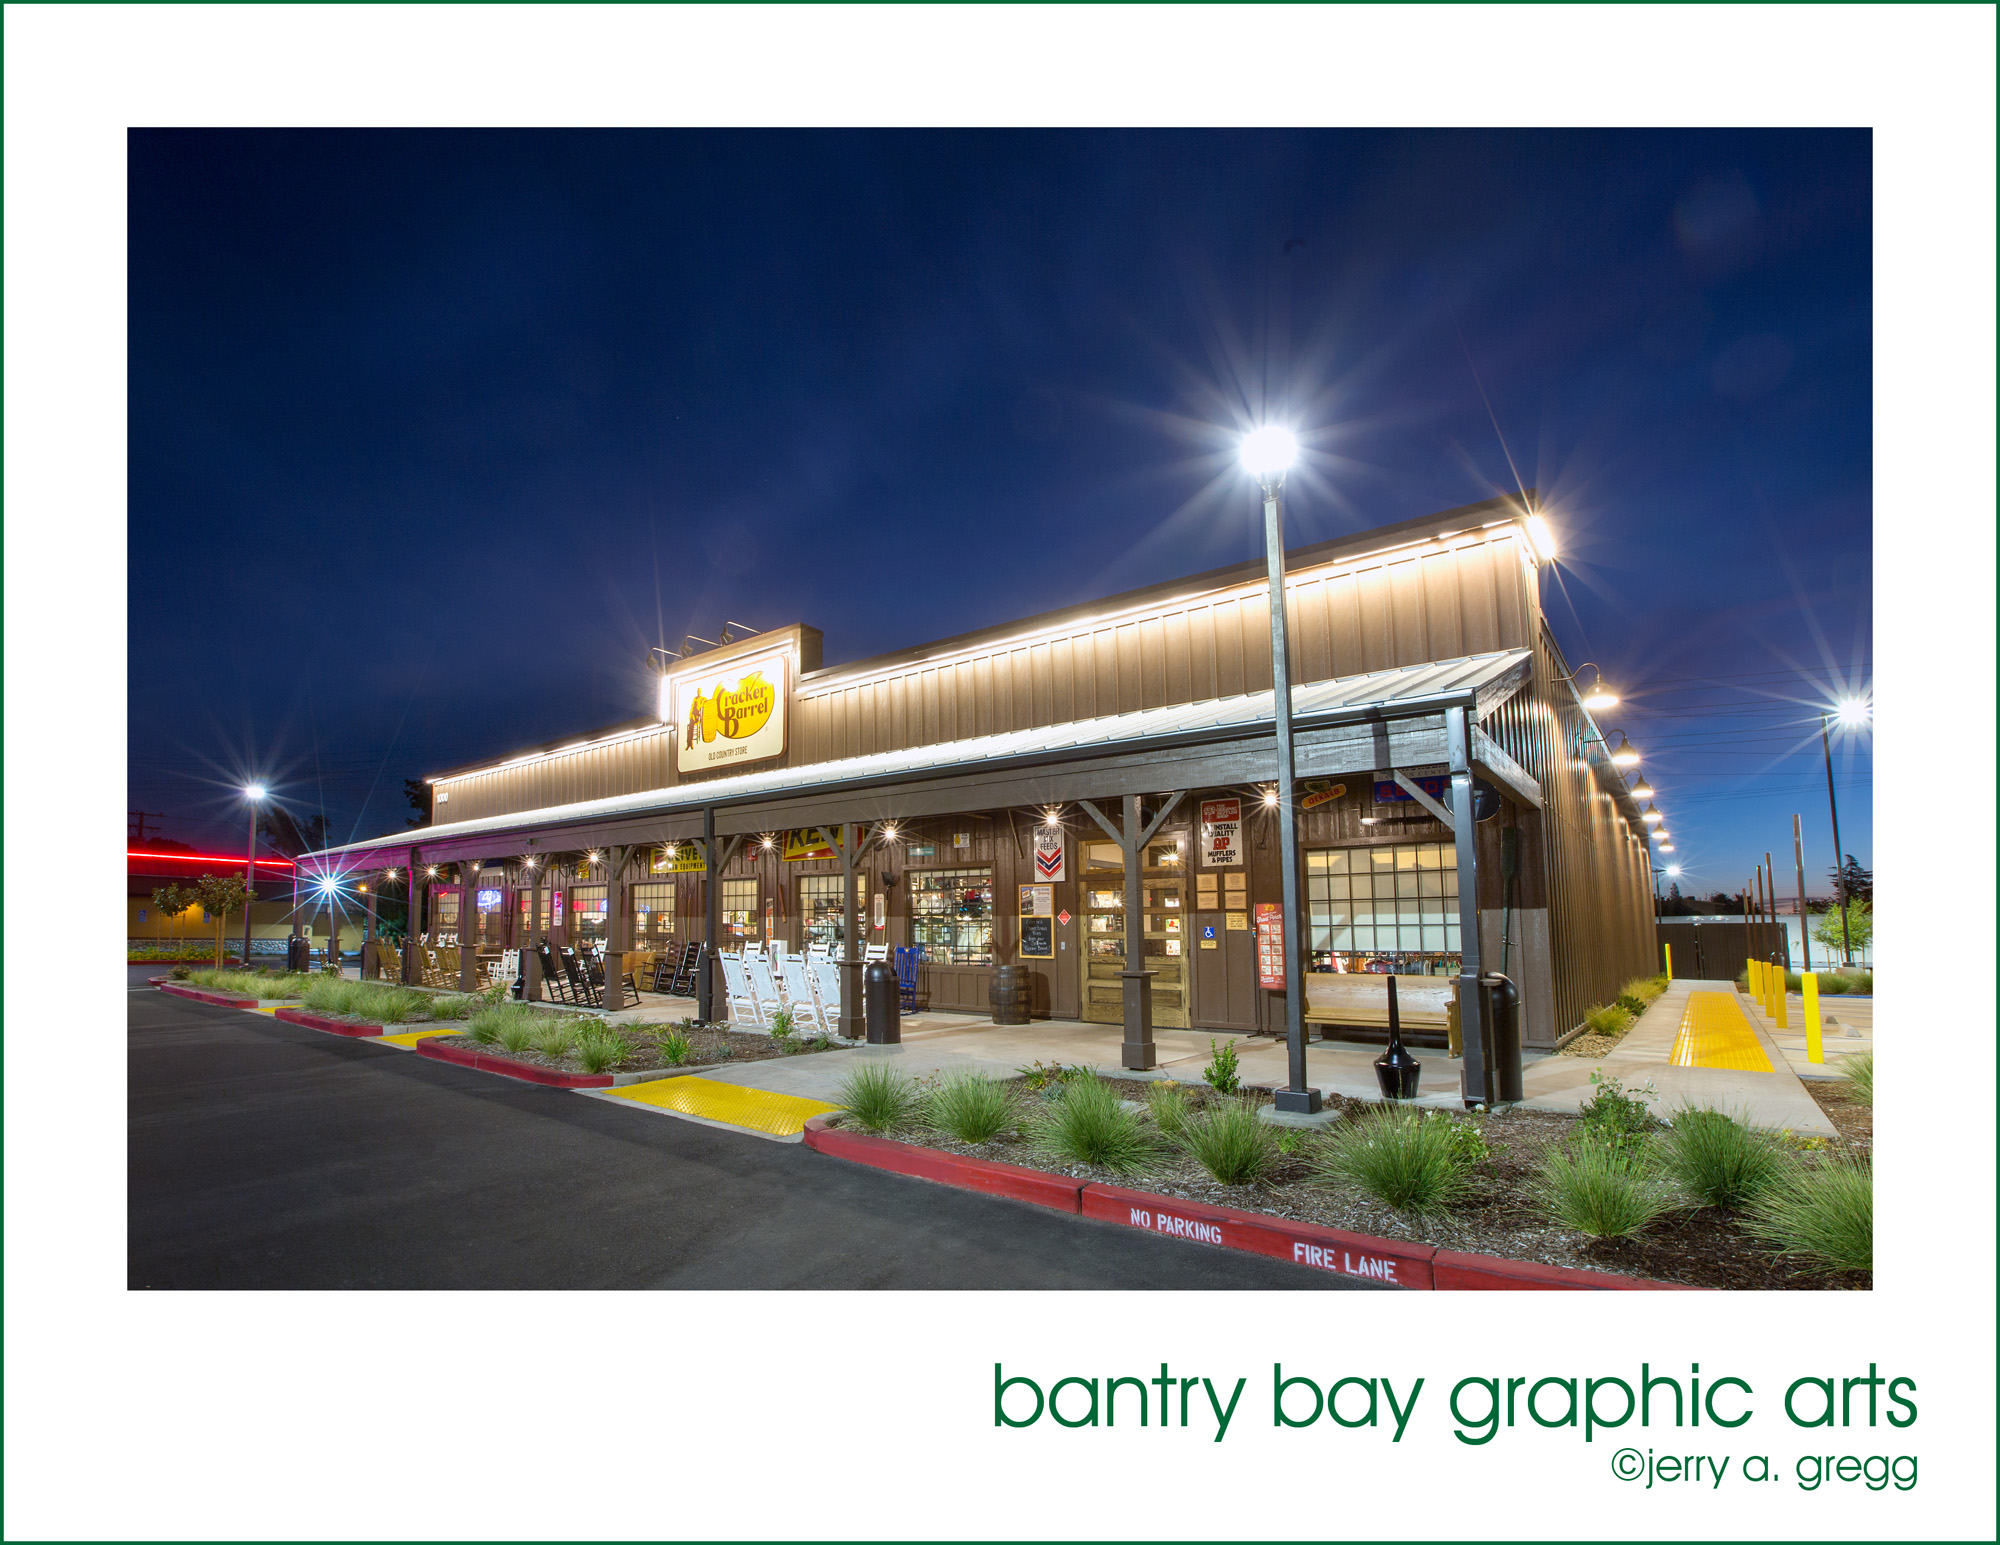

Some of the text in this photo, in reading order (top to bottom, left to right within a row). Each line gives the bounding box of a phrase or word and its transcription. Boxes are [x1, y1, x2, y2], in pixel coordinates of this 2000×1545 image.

[716, 686, 767, 721] Cracker
[725, 697, 768, 738] Barrel
[708, 746, 747, 760] OLD COUNTRY STORE
[1308, 788, 1340, 804] DEKALB
[1037, 828, 1060, 836] MASTER
[1214, 823, 1238, 831] INSTALL
[1040, 842, 1058, 850] FEEDS
[1213, 837, 1230, 850] AP
[1207, 850, 1236, 858] MUFFLERS
[1131, 1208, 1222, 1244] NO PARKING
[1294, 1242, 1398, 1283] FIRE LANE
